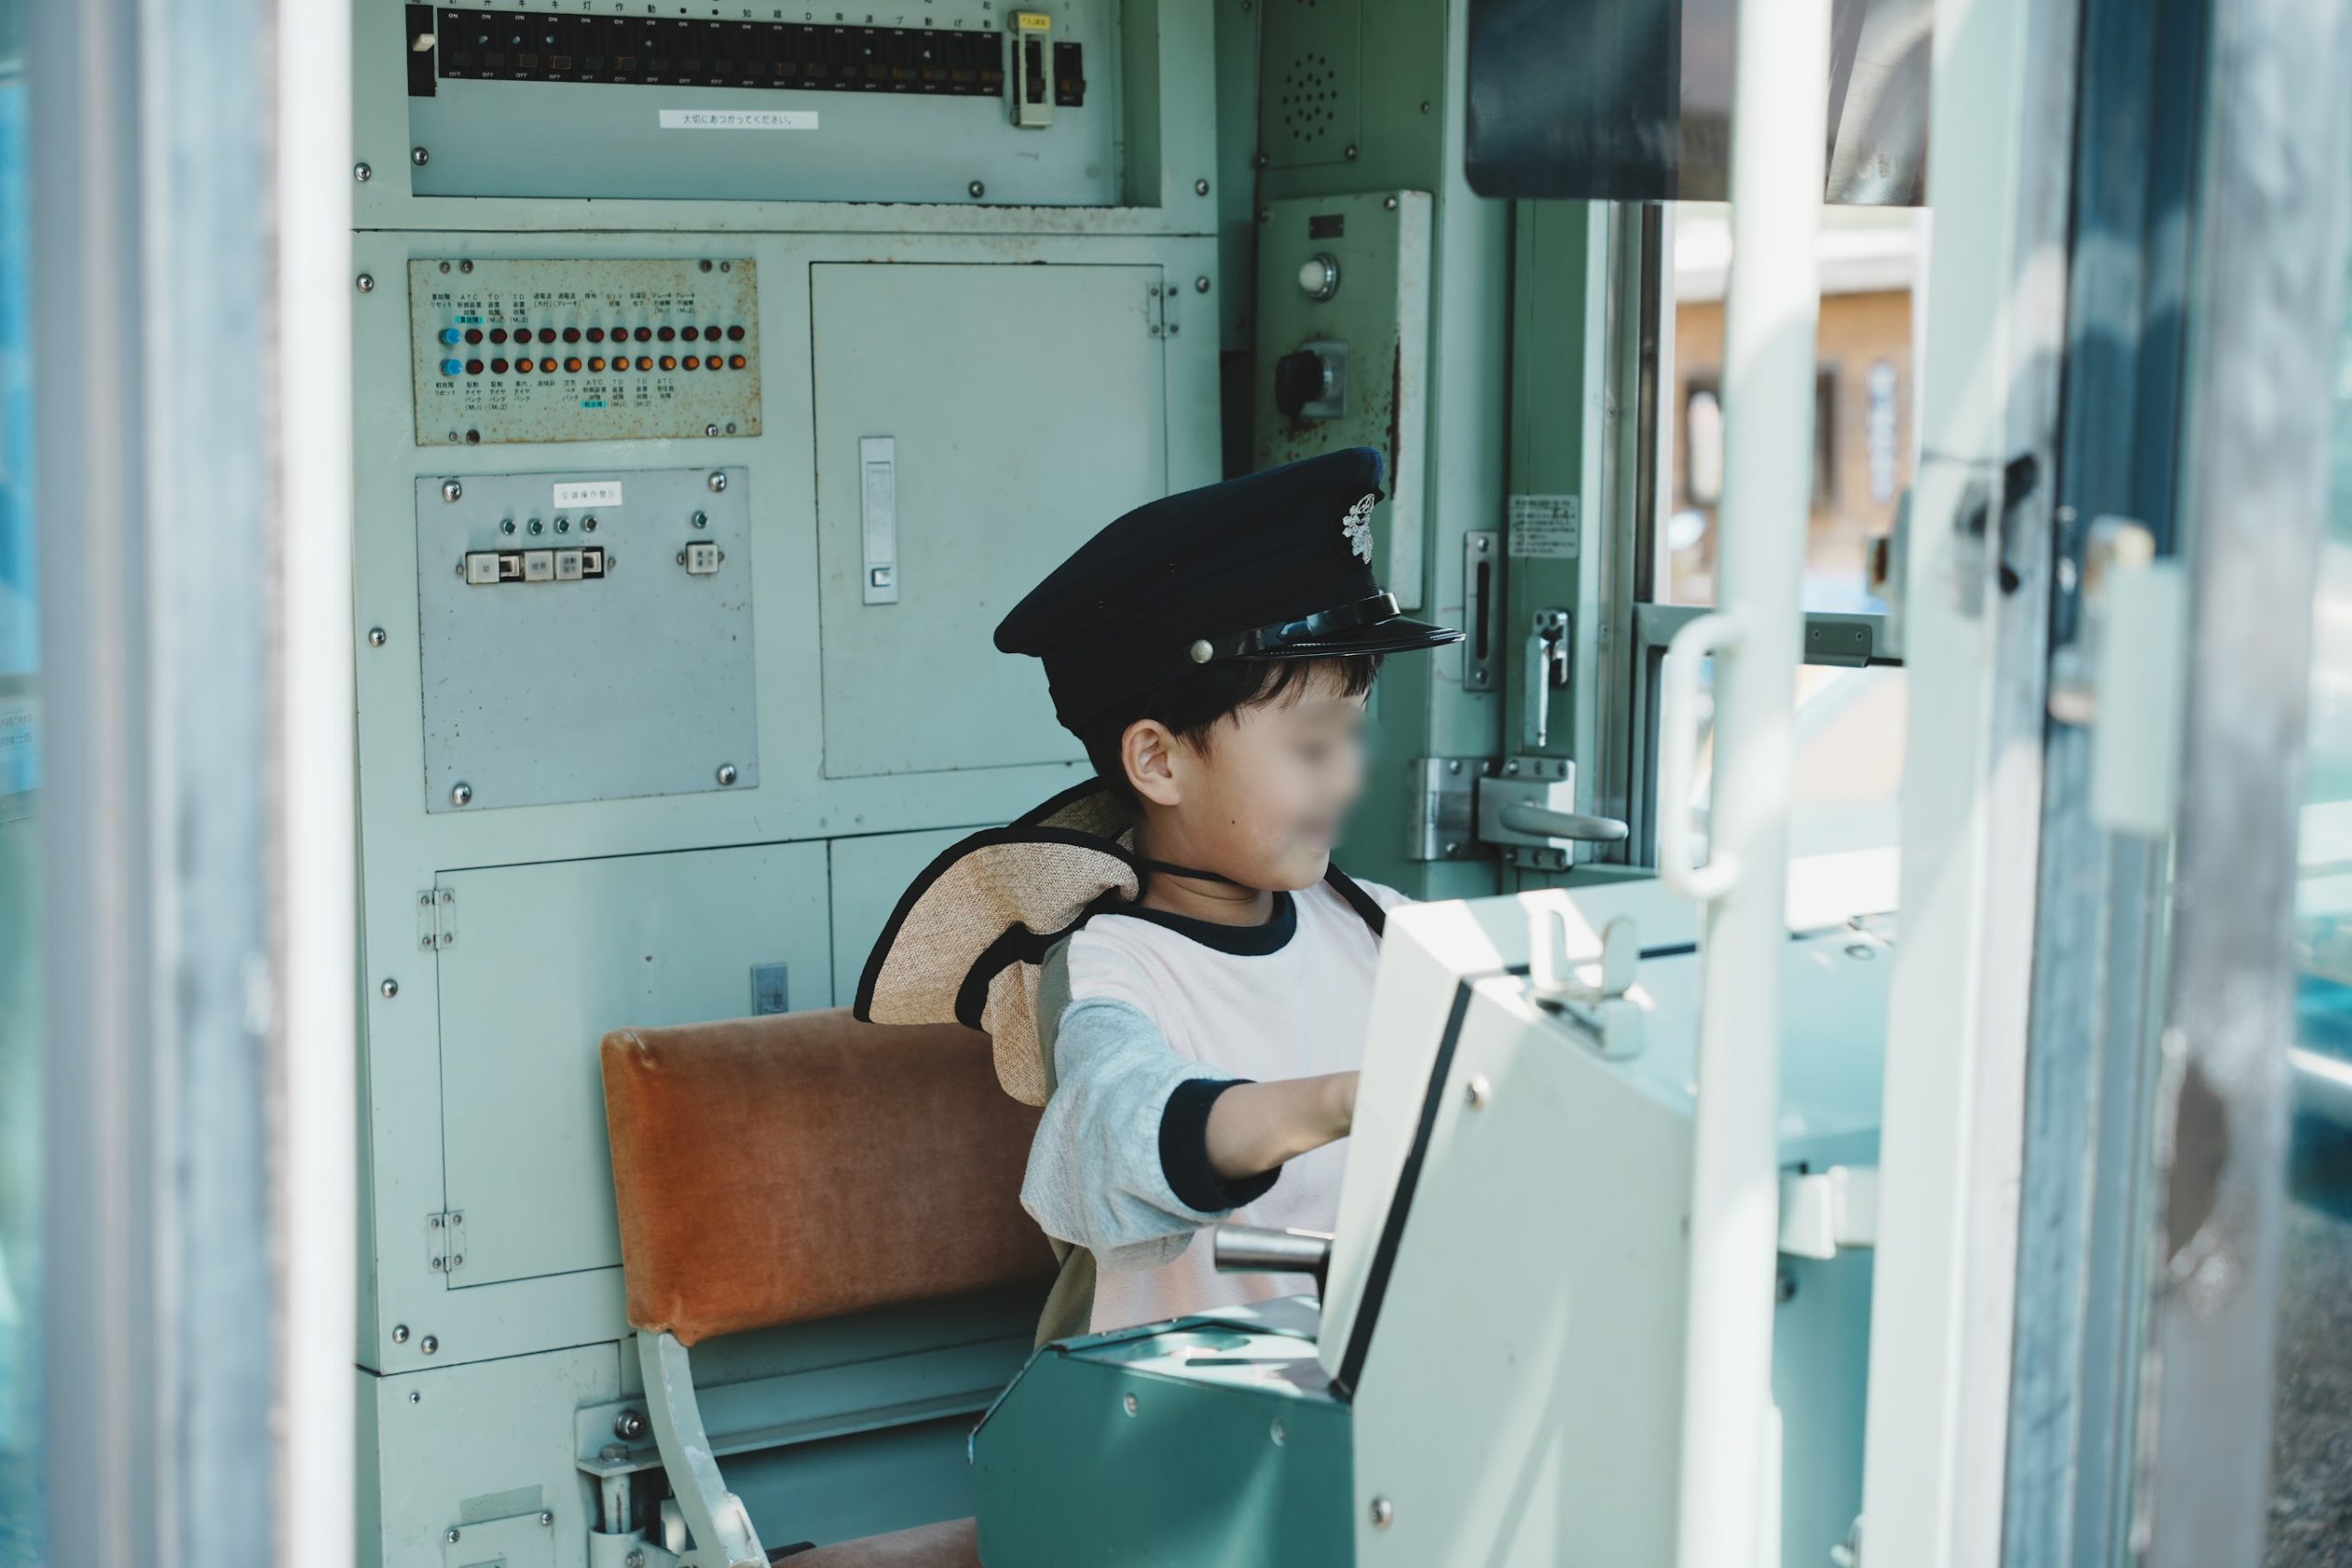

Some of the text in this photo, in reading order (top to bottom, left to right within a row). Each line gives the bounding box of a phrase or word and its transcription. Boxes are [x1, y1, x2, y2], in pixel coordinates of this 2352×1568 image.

[615, 3, 624, 12] 作
[684, 115, 792, 125] 大切にあつかってください。
